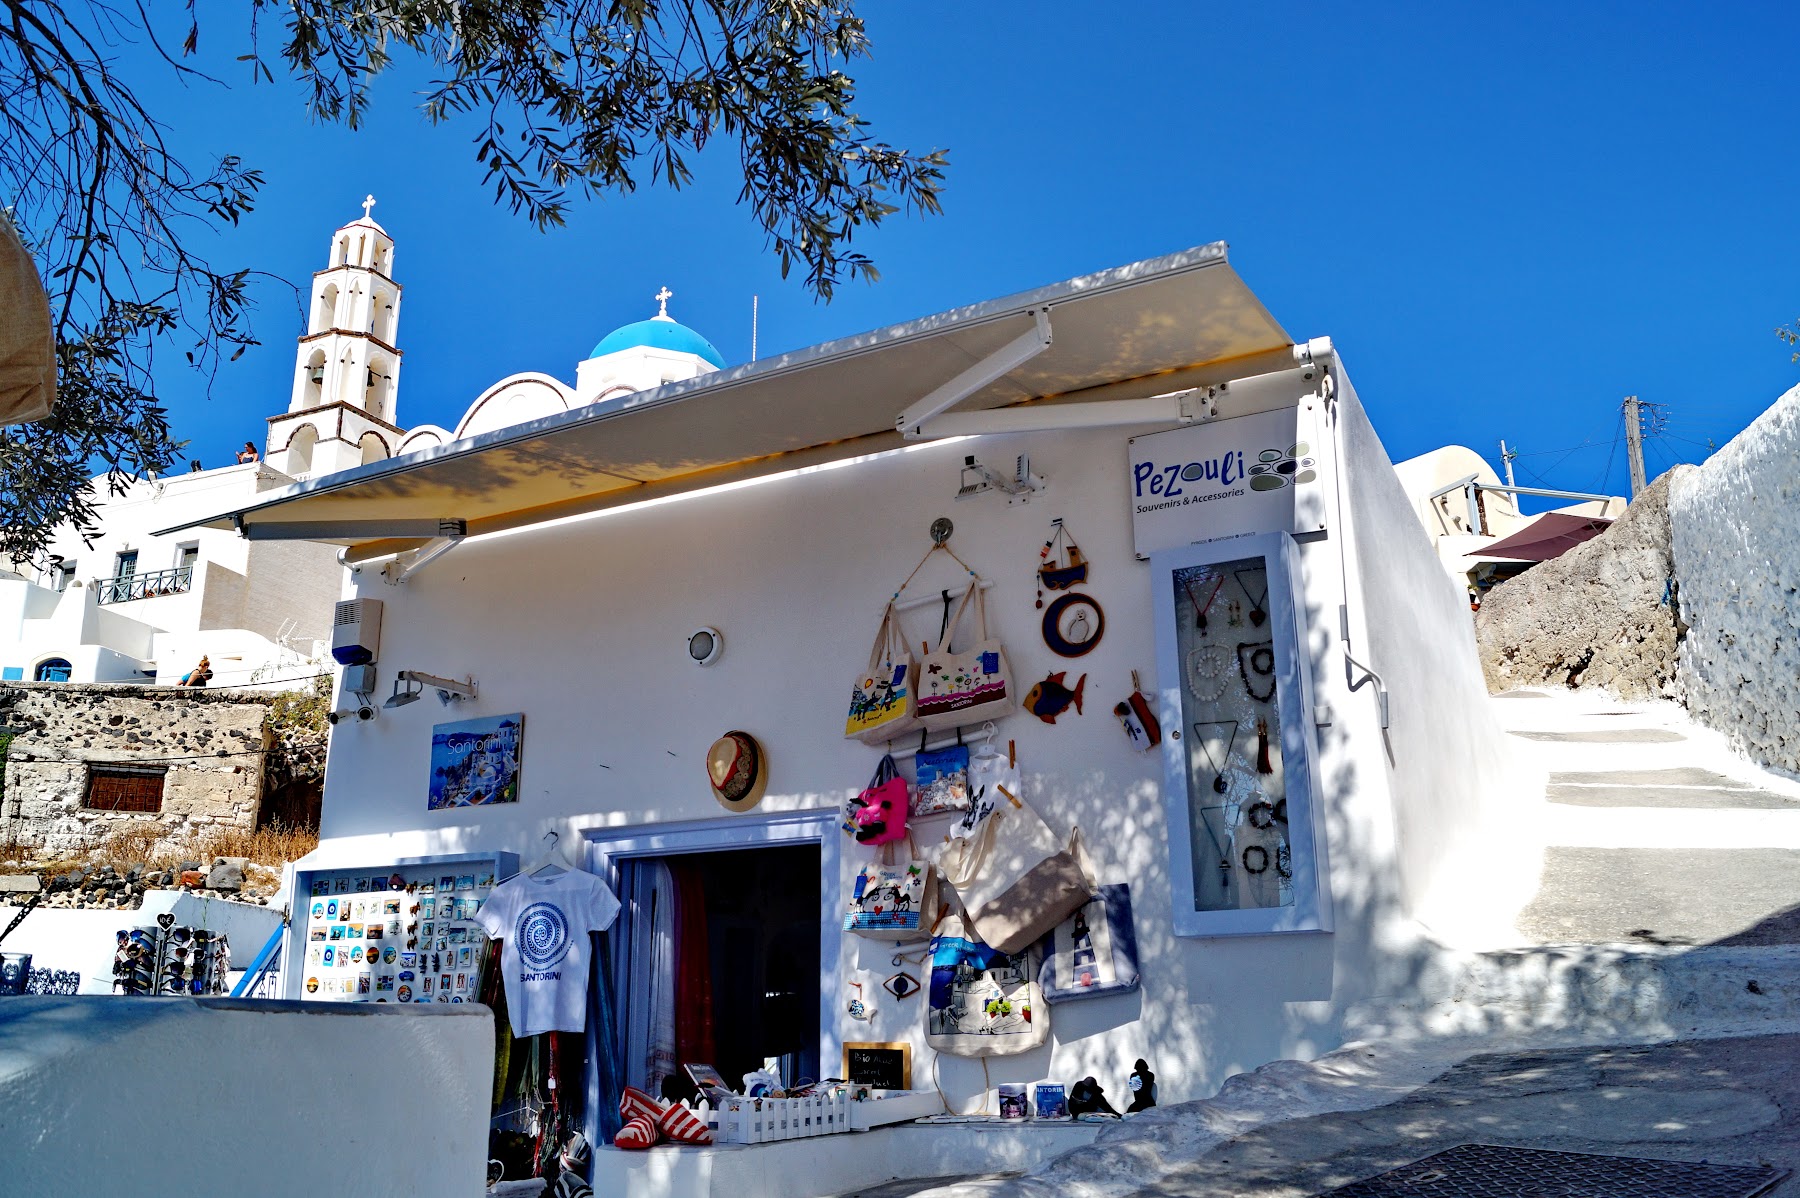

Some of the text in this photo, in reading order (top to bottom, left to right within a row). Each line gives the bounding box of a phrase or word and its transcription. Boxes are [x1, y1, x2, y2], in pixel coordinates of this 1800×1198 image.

[1136, 488, 1245, 514] Souvenirs & Accessories
[447, 735, 501, 755] Santorini
[520, 971, 562, 982] SANTORINI
